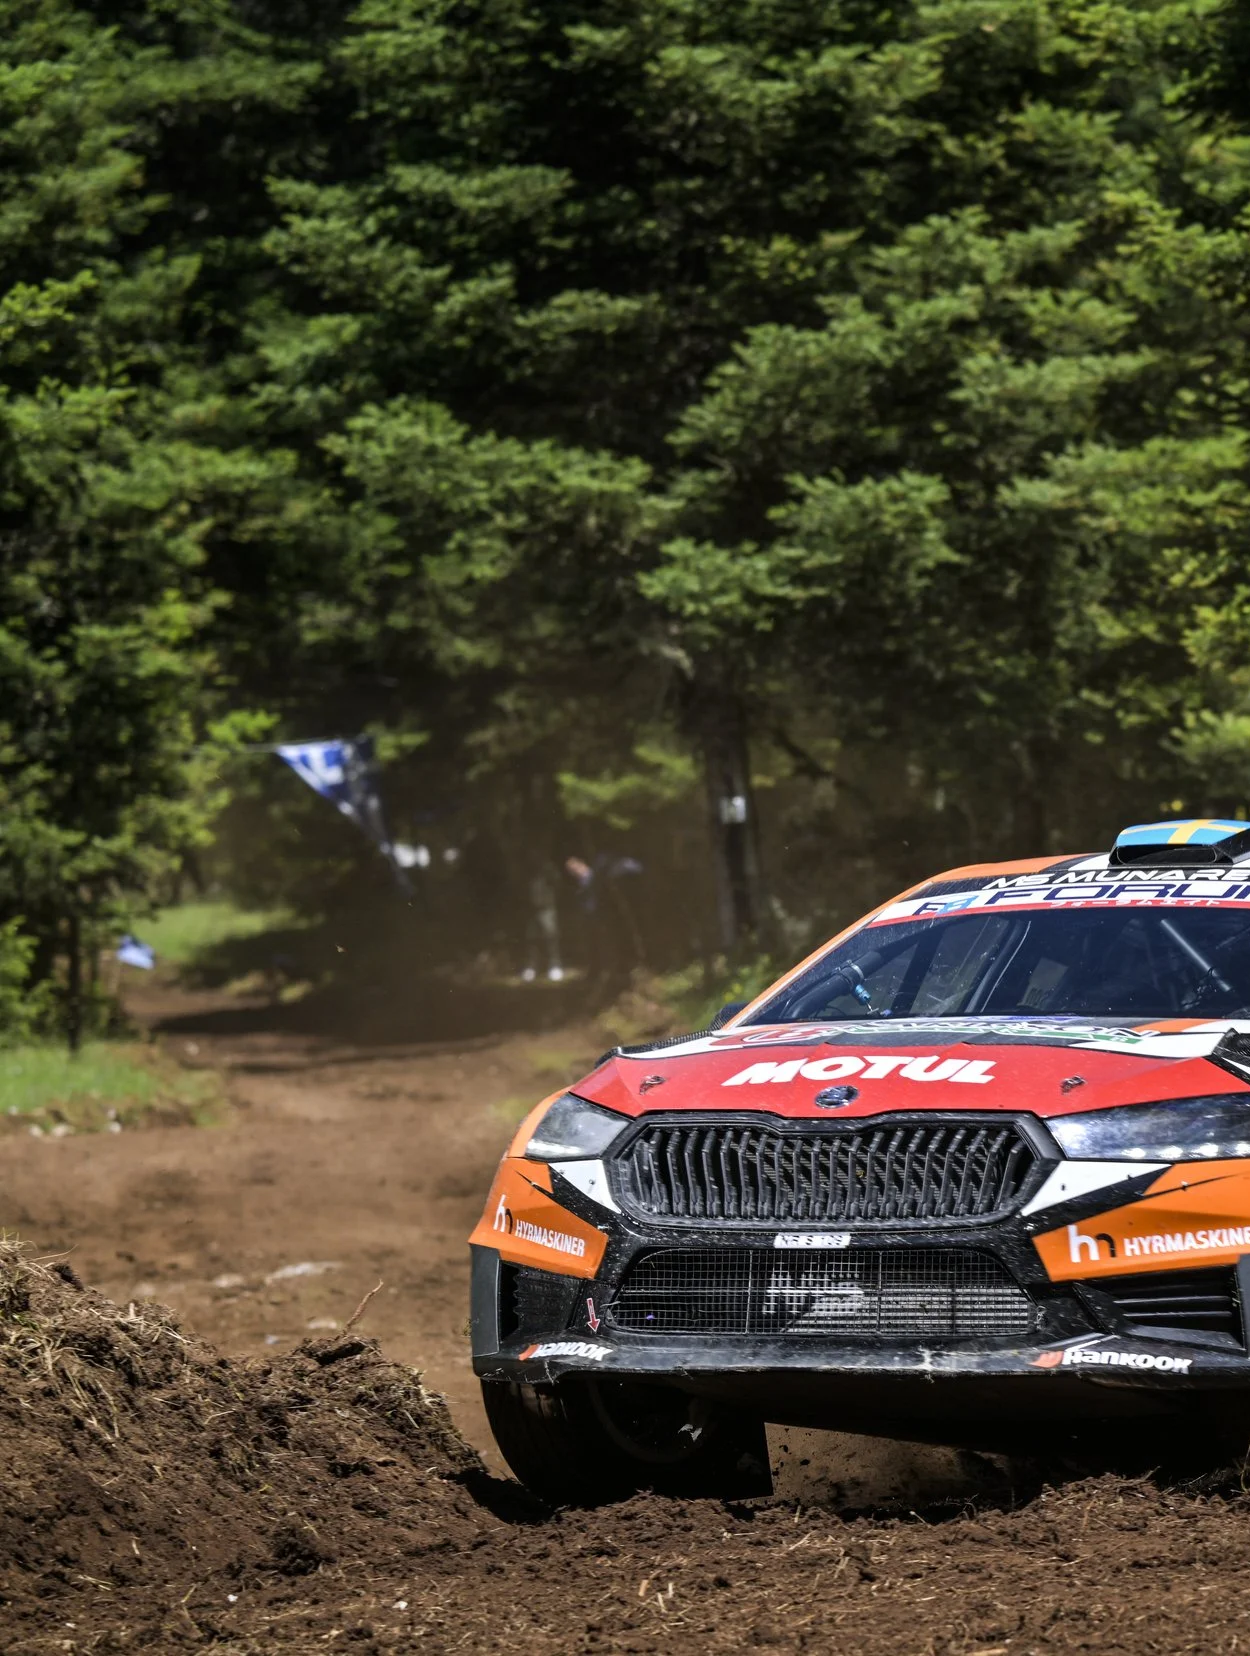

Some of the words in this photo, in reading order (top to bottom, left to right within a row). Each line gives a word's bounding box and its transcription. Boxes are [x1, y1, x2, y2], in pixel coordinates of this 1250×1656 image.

[982, 871, 1052, 890] MS
[721, 1055, 998, 1086] MOTUL
[515, 1218, 586, 1258] HYRMASKINER
